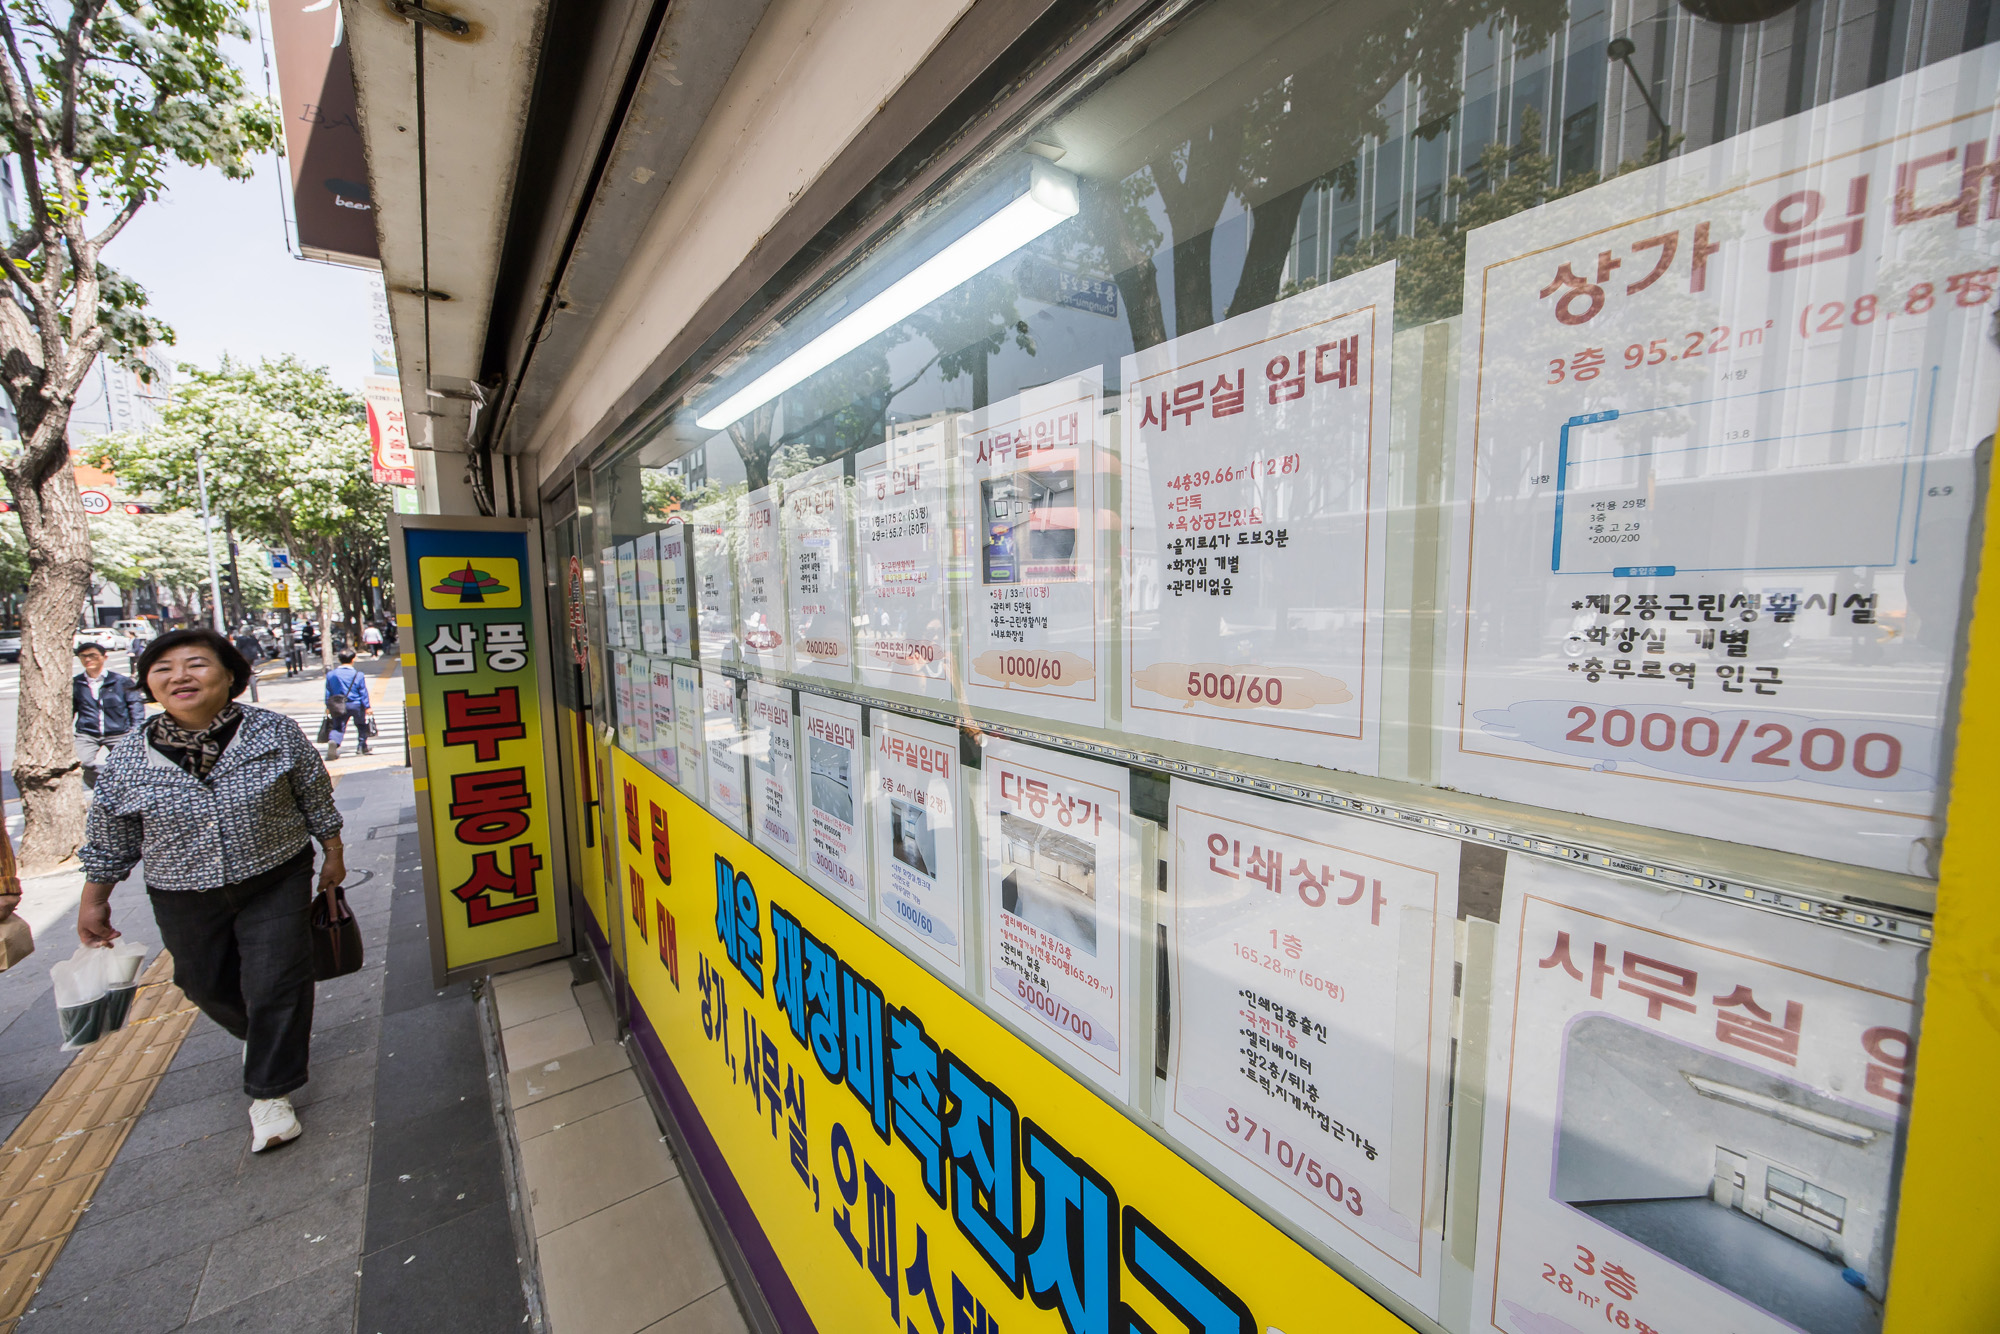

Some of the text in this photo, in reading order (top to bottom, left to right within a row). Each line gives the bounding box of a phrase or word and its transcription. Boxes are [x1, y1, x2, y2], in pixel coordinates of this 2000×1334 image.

[335, 194, 371, 211] beer
[1539, 134, 2000, 325] 상가 임대
[1139, 333, 1359, 432] 사무실 임대
[1546, 347, 1606, 385] 3층
[1721, 368, 1748, 383] 서향
[386, 410, 407, 464] 실사출력
[976, 411, 1079, 467] 사무실임대
[1725, 429, 1750, 441] 13.8
[893, 463, 921, 495] 임대
[1531, 475, 1550, 485] 남향
[1928, 486, 1954, 498] 6.9
[1590, 513, 1606, 523] 3층
[1622, 498, 1647, 509] 29평
[1236, 529, 1290, 548] 도보3분
[1609, 523, 1620, 533] 고
[1624, 522, 1640, 532] 2.9
[1214, 555, 1240, 573] 개별
[425, 623, 528, 675] 삼풍
[806, 640, 838, 656] 2600/250
[1686, 627, 1751, 659] 개별
[998, 655, 1062, 681] 1000/60
[1714, 664, 1784, 696] 인근
[1187, 671, 1283, 706] 500/60
[753, 700, 789, 729] 사무실임대
[807, 715, 855, 750] 사무실임대
[1565, 705, 1904, 779] 2000/200
[879, 734, 949, 780] 사무실임대
[882, 776, 894, 793] 2층
[442, 686, 544, 928] 부동산
[1000, 770, 1103, 837] 다동상가
[1400, 813, 1423, 824] SAMSUNG
[622, 777, 672, 887] 빌딩
[815, 852, 855, 887] 3000/150.8
[1207, 832, 1388, 927] 인쇄상가
[1612, 861, 1643, 874] SAMSUNG
[628, 863, 681, 994] 매매
[714, 852, 765, 1000] 세운
[895, 899, 934, 934] 1000/60
[1040, 932, 1073, 960] 있음/3층
[1269, 928, 1304, 960] 1층
[1026, 955, 1042, 973] 없음
[1017, 979, 1093, 1042] 5000/700
[1538, 930, 1804, 1068] 사무실
[697, 950, 737, 1086] 상가,
[743, 1006, 820, 1214] 사무실,
[1225, 1106, 1365, 1217] 3710/503
[1573, 1244, 1639, 1301] 3층
